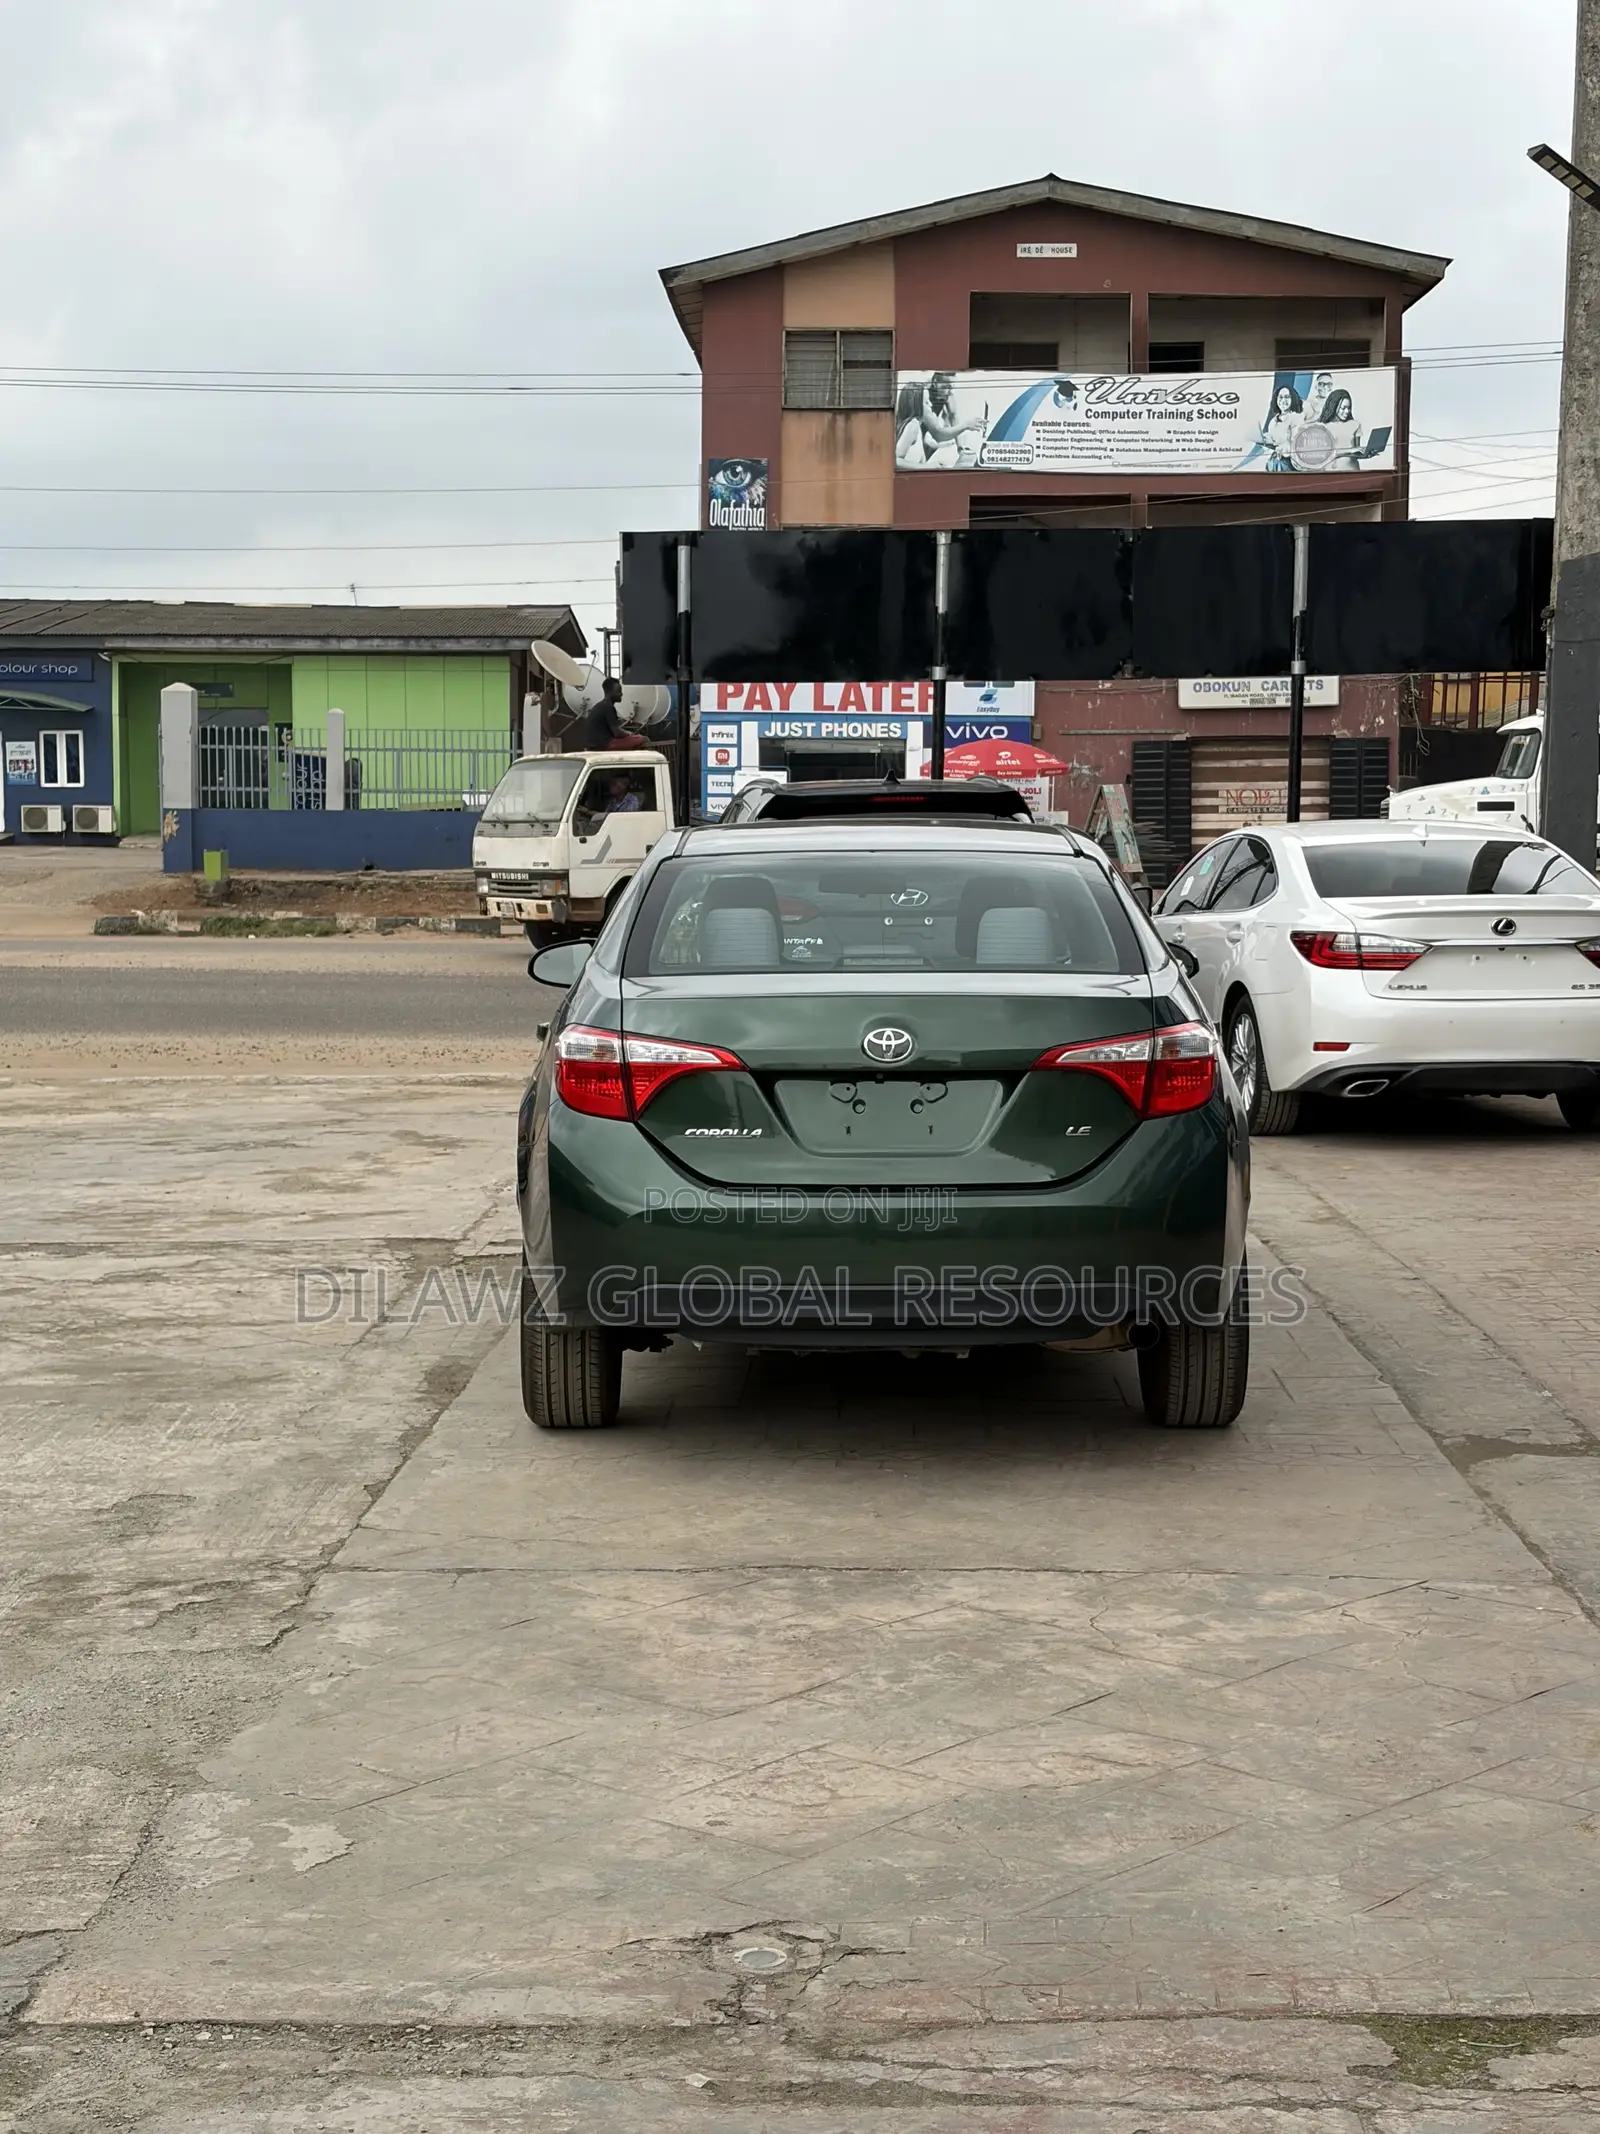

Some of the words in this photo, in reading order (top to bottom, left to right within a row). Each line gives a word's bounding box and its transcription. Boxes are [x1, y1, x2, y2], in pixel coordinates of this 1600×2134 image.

[1085, 408, 1143, 421] Computer
[1146, 408, 1193, 421] Training
[1196, 408, 1237, 420] School
[41, 663, 78, 676] shop
[1192, 681, 1251, 693] OBOKUN
[717, 682, 797, 711] PAY
[764, 721, 816, 738] JUST
[821, 721, 902, 738] PHONES
[946, 722, 1009, 739] vivo
[491, 872, 529, 880] MITSUBISHI
[684, 1128, 763, 1138] COROLLA
[1065, 1126, 1092, 1136] LE
